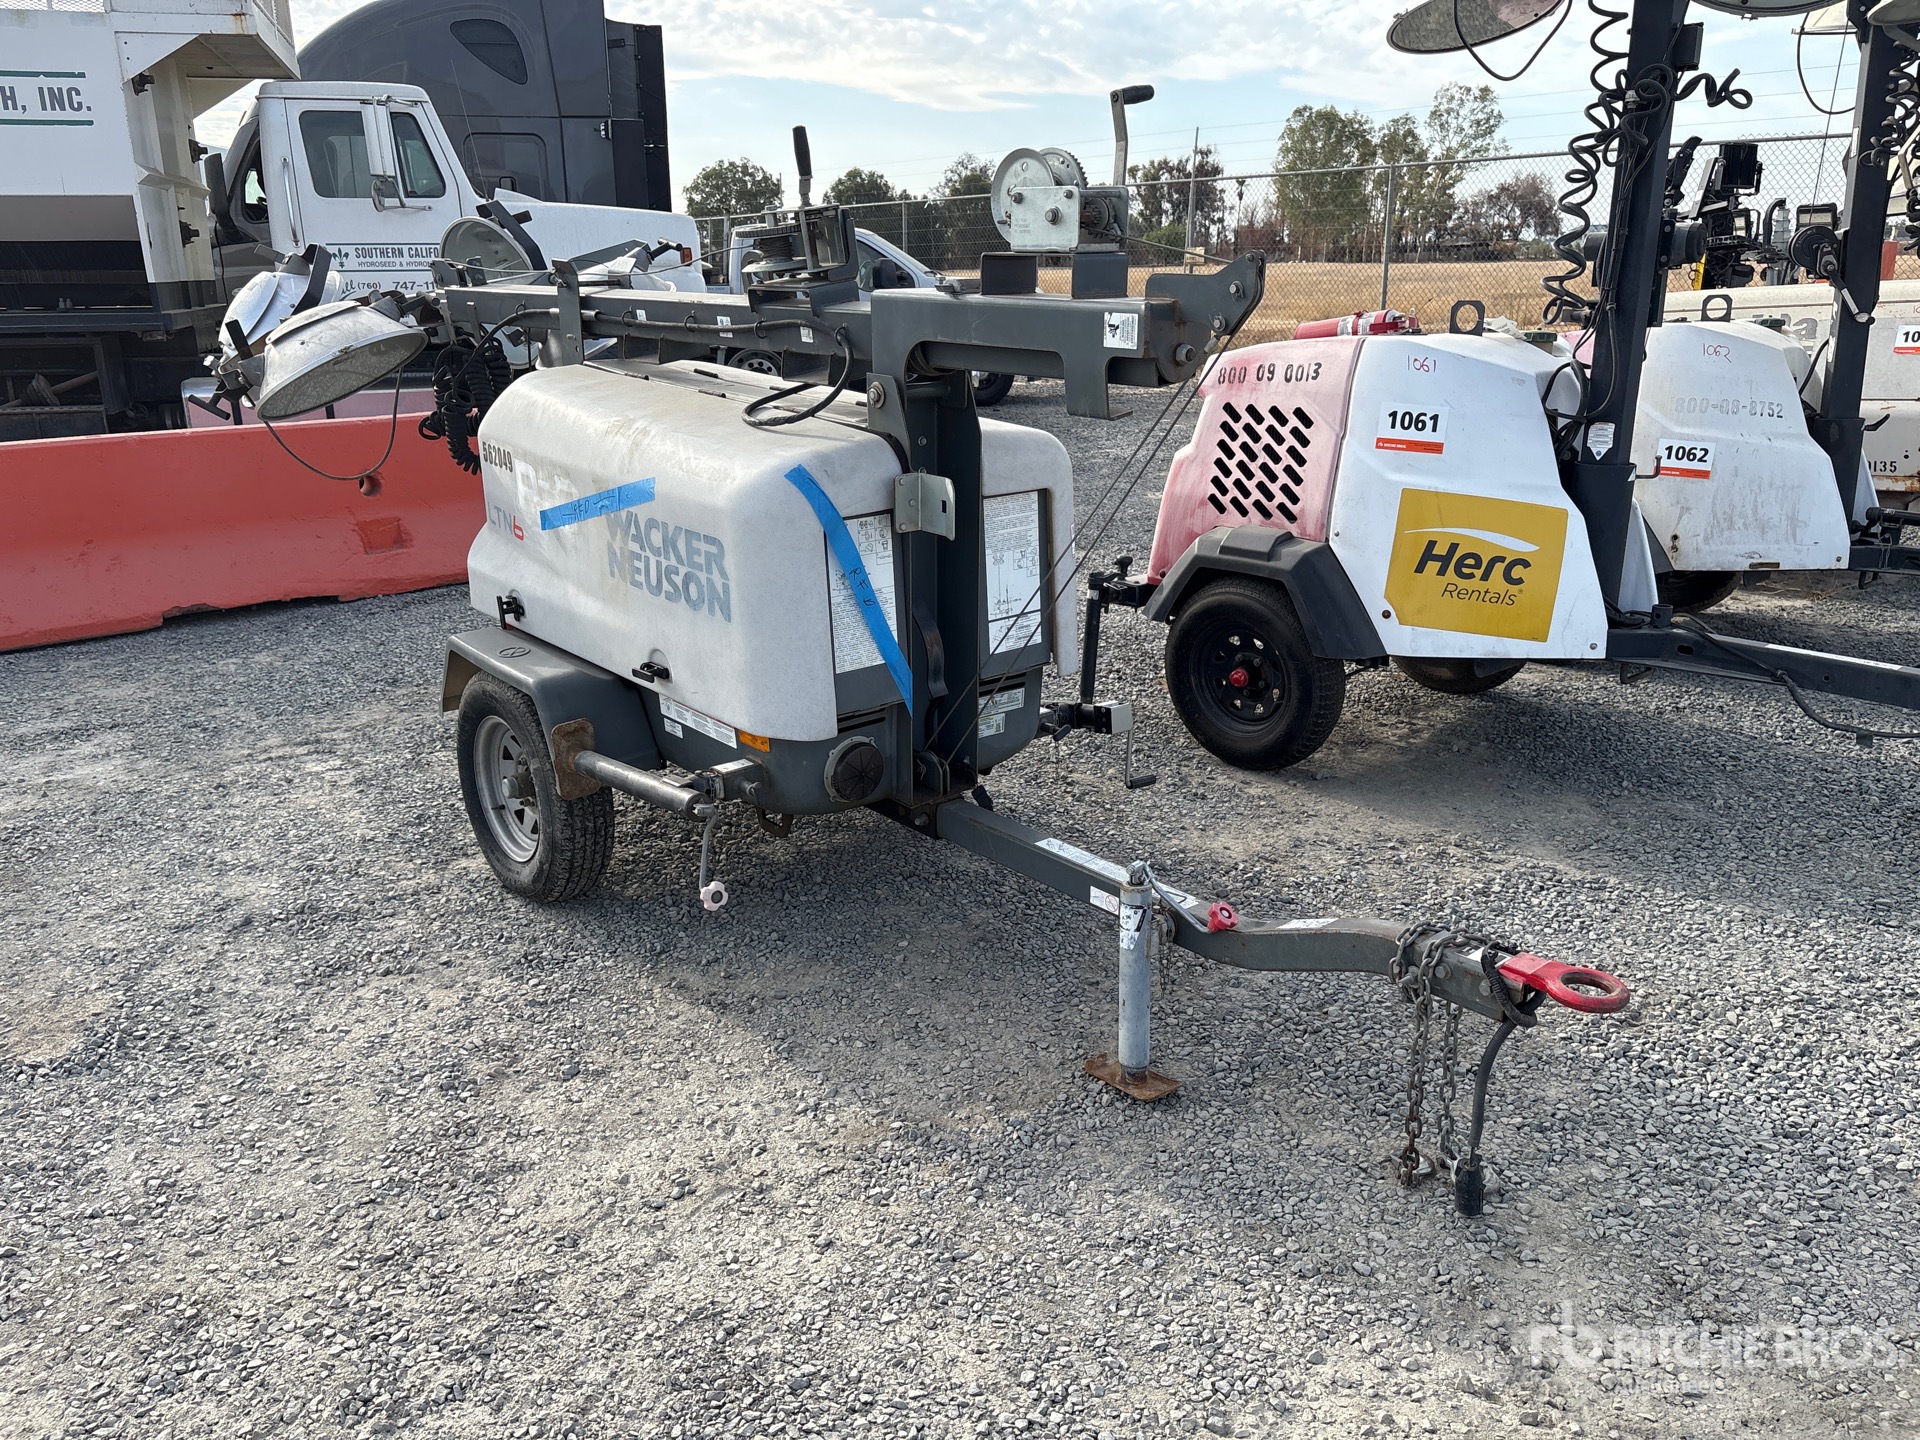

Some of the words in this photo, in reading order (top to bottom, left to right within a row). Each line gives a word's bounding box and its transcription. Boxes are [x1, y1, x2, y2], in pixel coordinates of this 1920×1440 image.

[37, 86, 92, 112] INC.
[354, 247, 405, 259] SOUTHERN
[357, 260, 397, 268] HYDROSEED
[357, 281, 382, 291] (760)
[1217, 365, 1248, 385] 800
[1256, 362, 1276, 382] 09
[1284, 362, 1323, 383] 0013
[1406, 355, 1438, 373] 1061
[1387, 410, 1440, 433] 1061
[481, 441, 514, 473] 562049
[1664, 445, 1710, 464] 1062
[605, 509, 731, 582] WACKER
[1413, 539, 1532, 586] Herc
[607, 540, 732, 623] NEUSON
